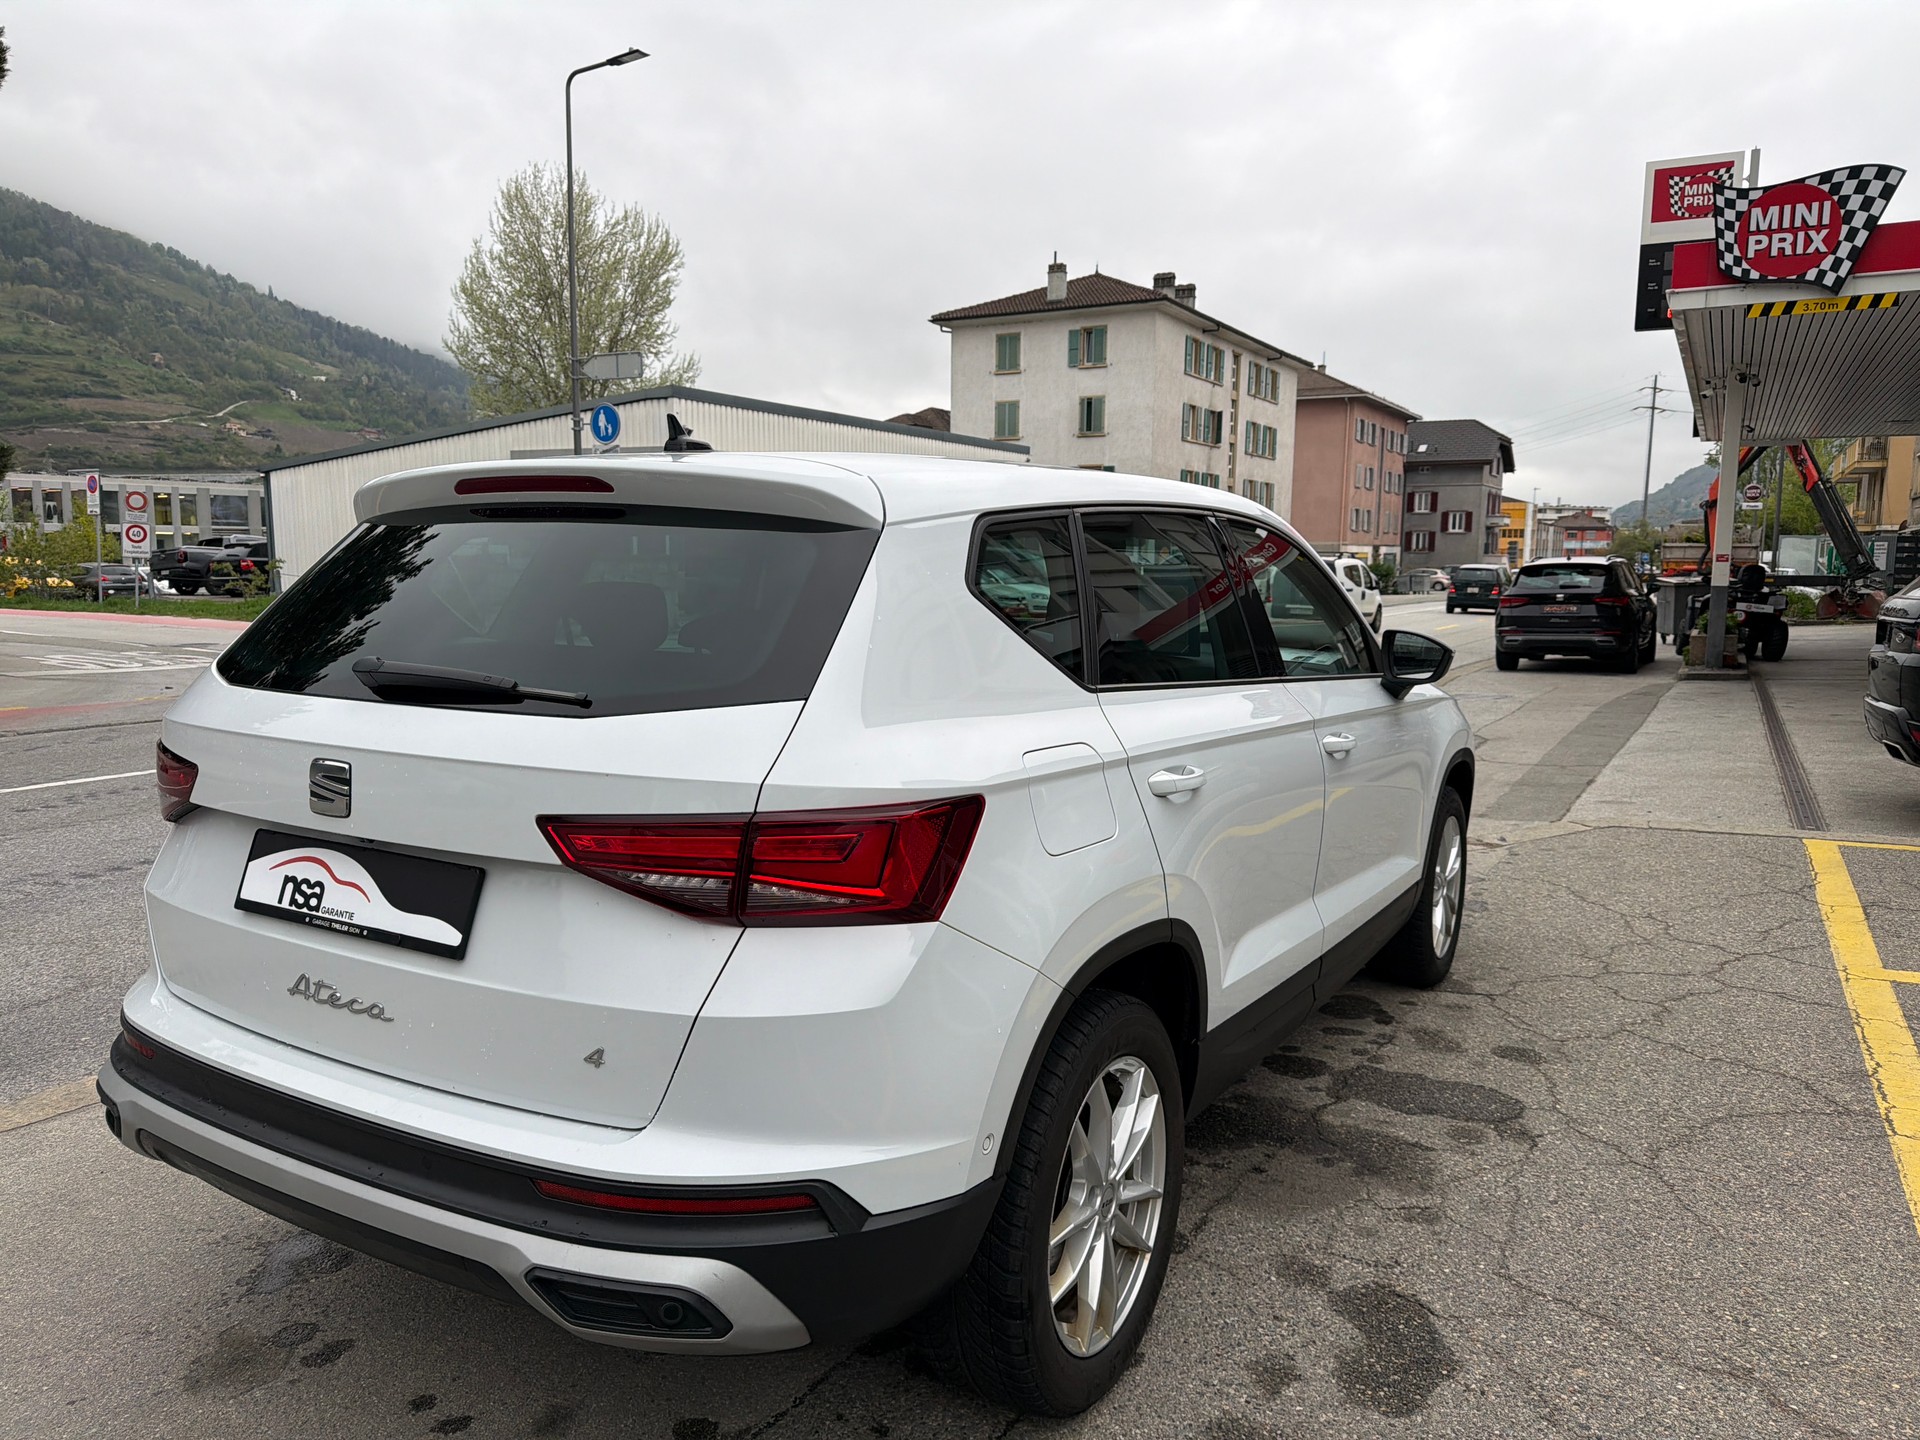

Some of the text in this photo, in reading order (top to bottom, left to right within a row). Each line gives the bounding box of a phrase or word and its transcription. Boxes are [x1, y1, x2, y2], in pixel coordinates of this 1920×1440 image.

[1684, 182, 1714, 196] MIN
[1749, 200, 1832, 232] MINI
[1747, 229, 1830, 259] PRIX
[131, 530, 141, 538] 40
[277, 874, 325, 913] nsa
[320, 906, 355, 921] GARANTIE
[311, 918, 331, 927] GARAGE
[331, 922, 349, 932] THELER
[287, 972, 395, 1022] Ateca
[584, 1047, 606, 1068] 4
